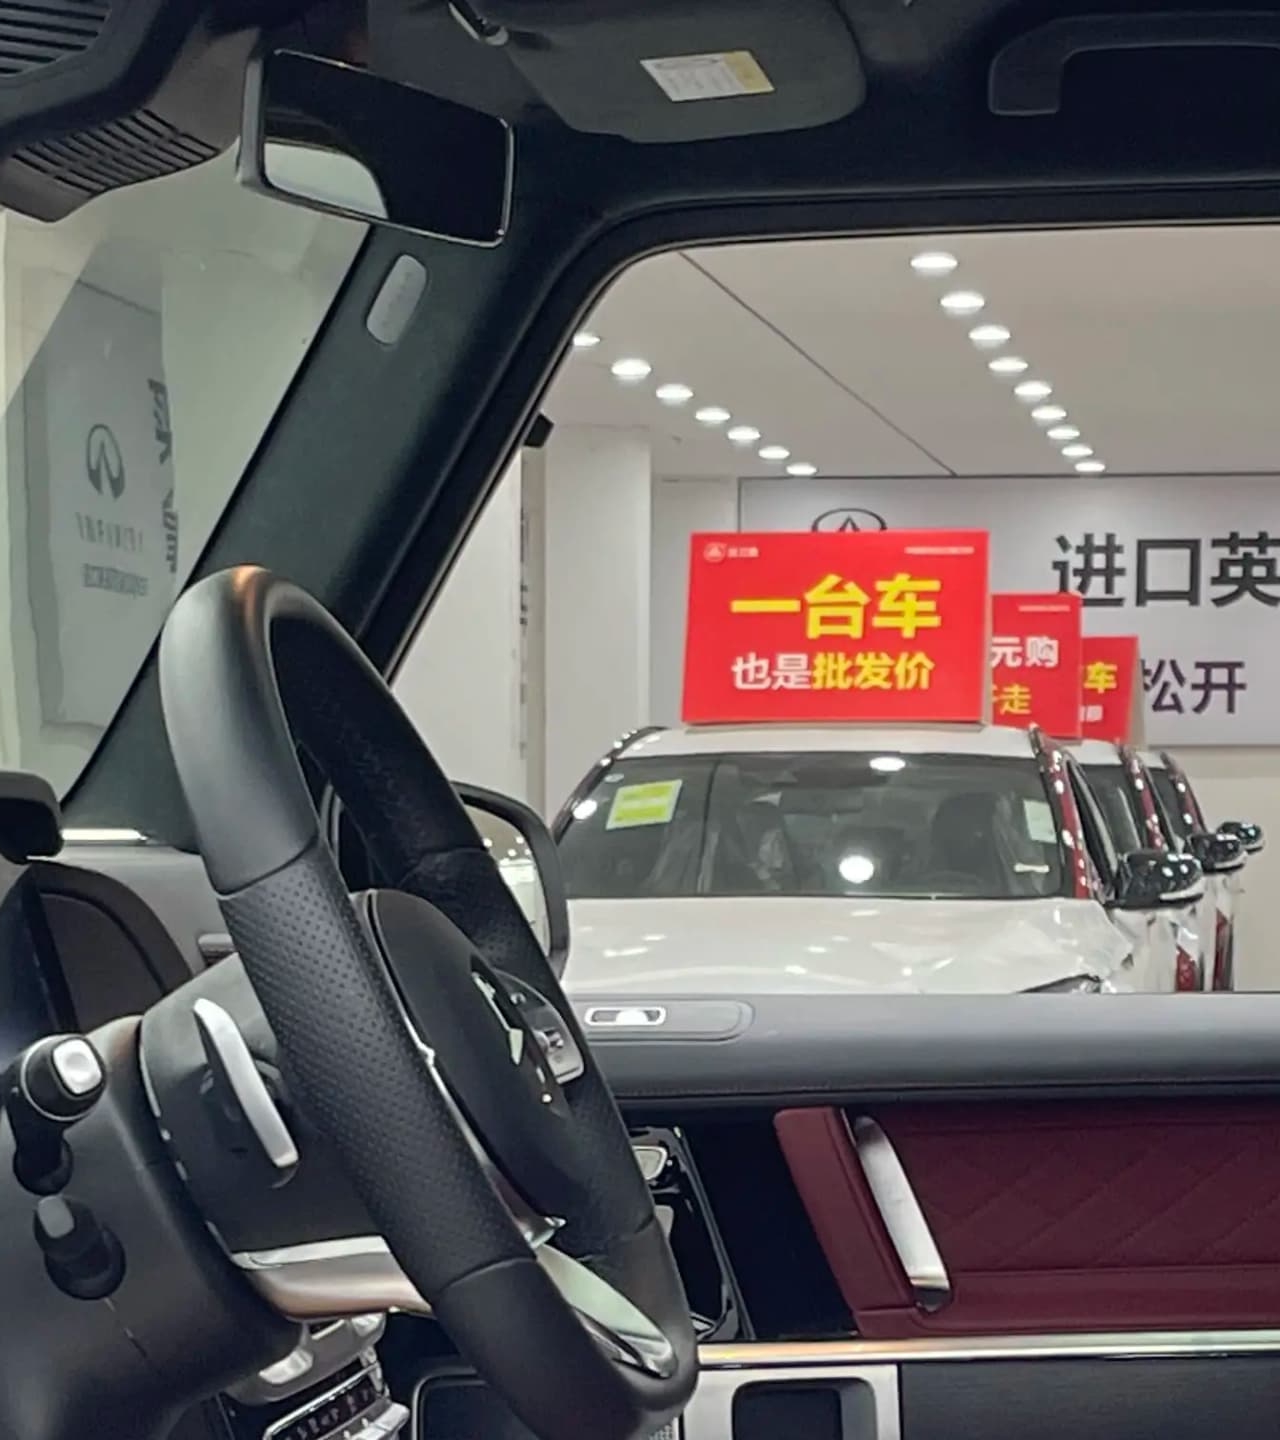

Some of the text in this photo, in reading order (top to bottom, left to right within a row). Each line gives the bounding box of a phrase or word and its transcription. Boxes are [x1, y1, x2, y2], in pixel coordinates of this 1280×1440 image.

[730, 573, 942, 639] 一台车
[731, 652, 935, 690] 也是批发价
[991, 683, 1032, 715] 走
